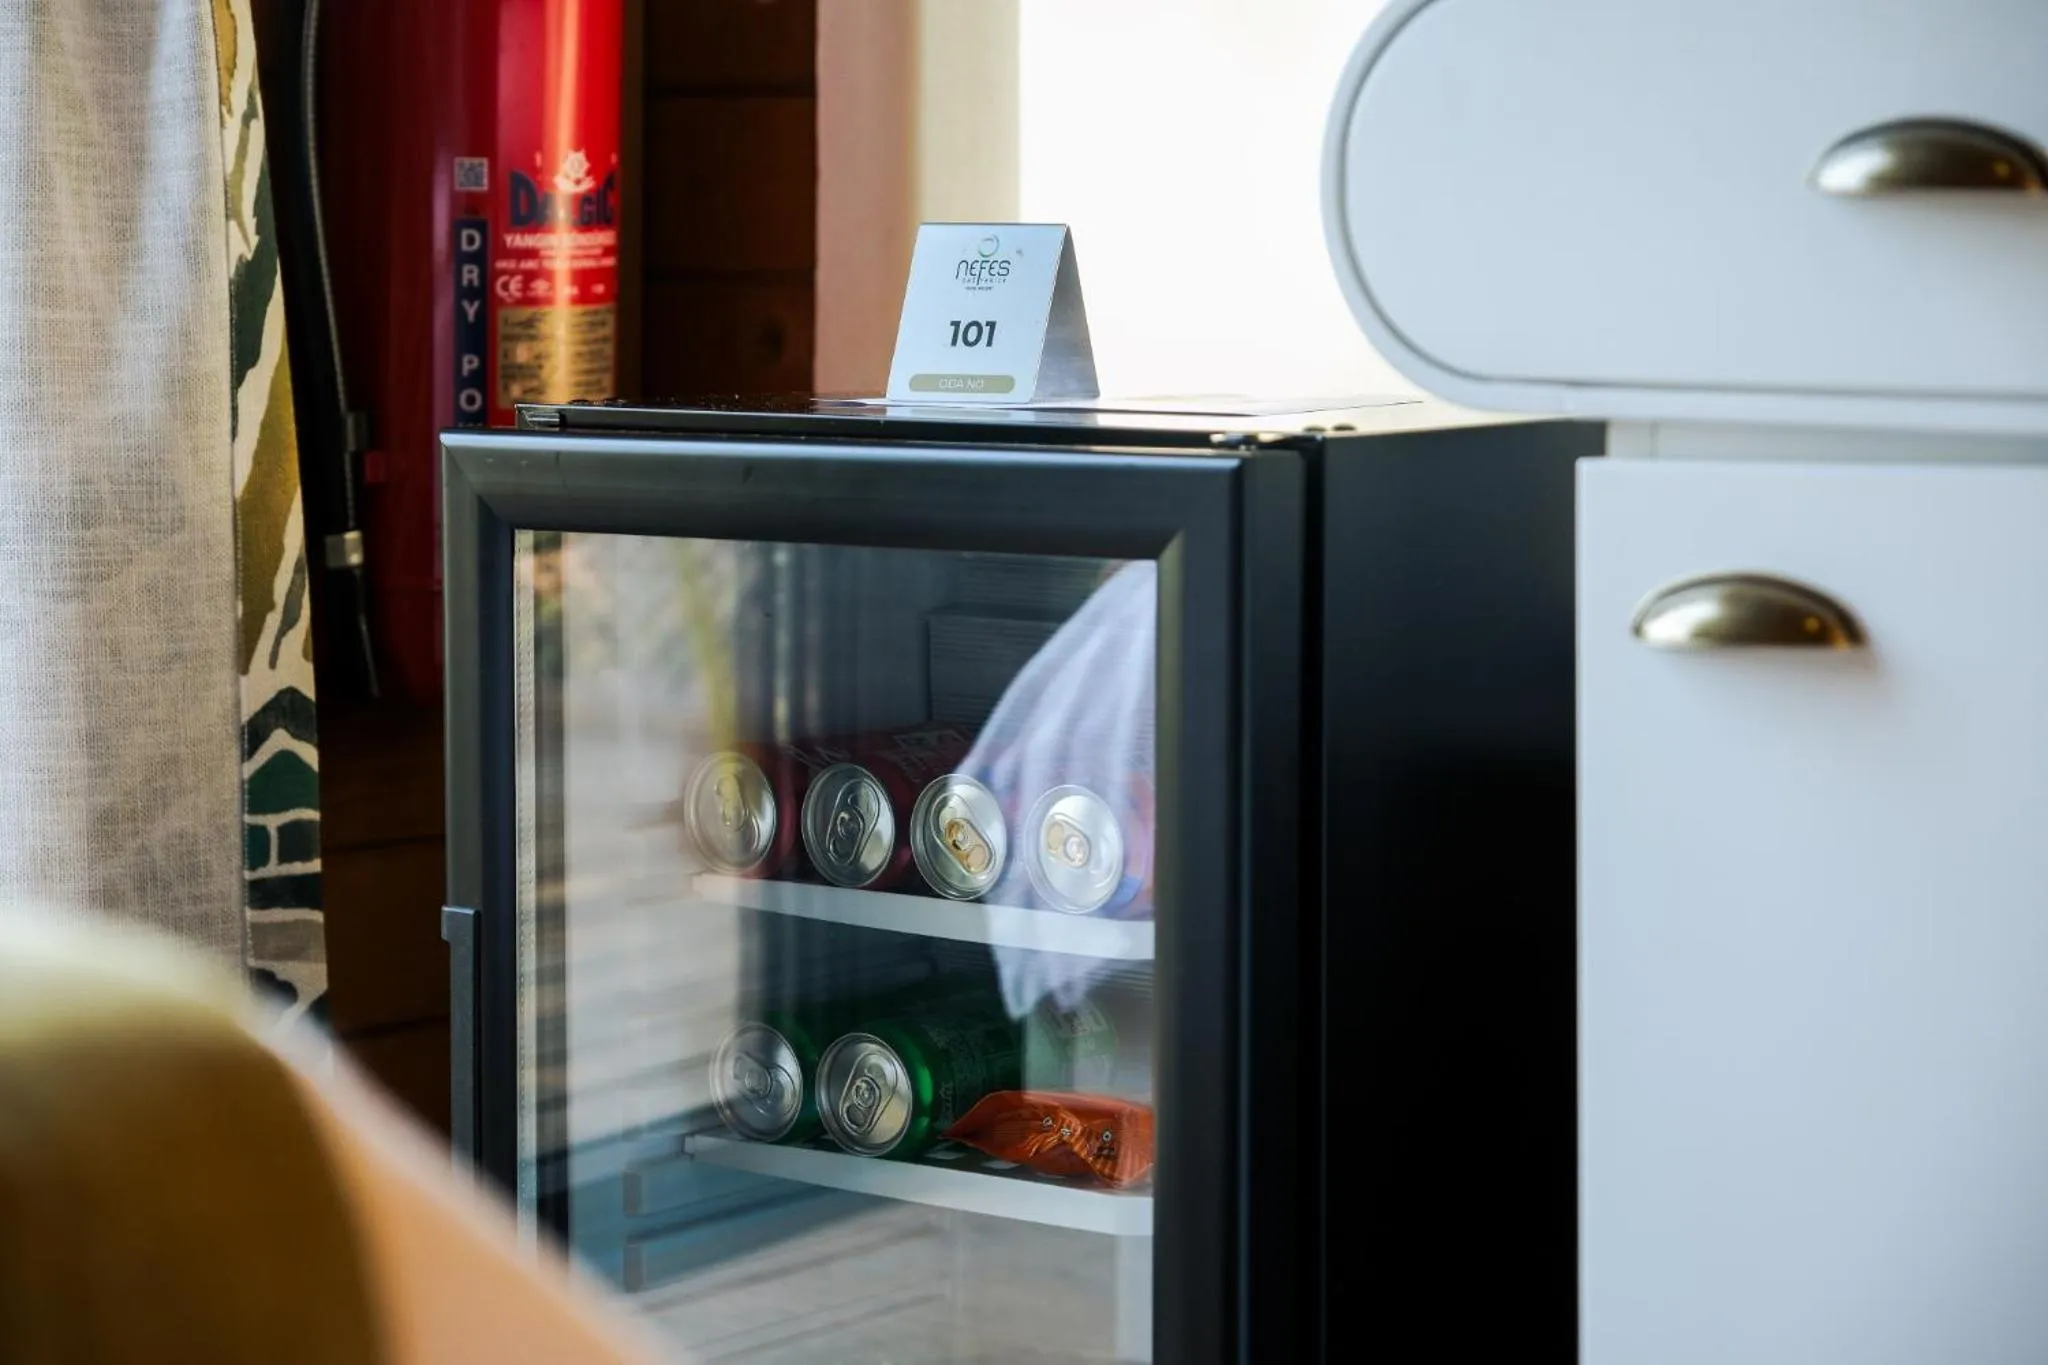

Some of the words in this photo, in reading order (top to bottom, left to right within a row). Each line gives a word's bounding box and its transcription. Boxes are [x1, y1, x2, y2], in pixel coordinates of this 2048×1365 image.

[460, 229, 481, 323] DRY
[949, 319, 997, 348] 101
[460, 355, 482, 428] PO
